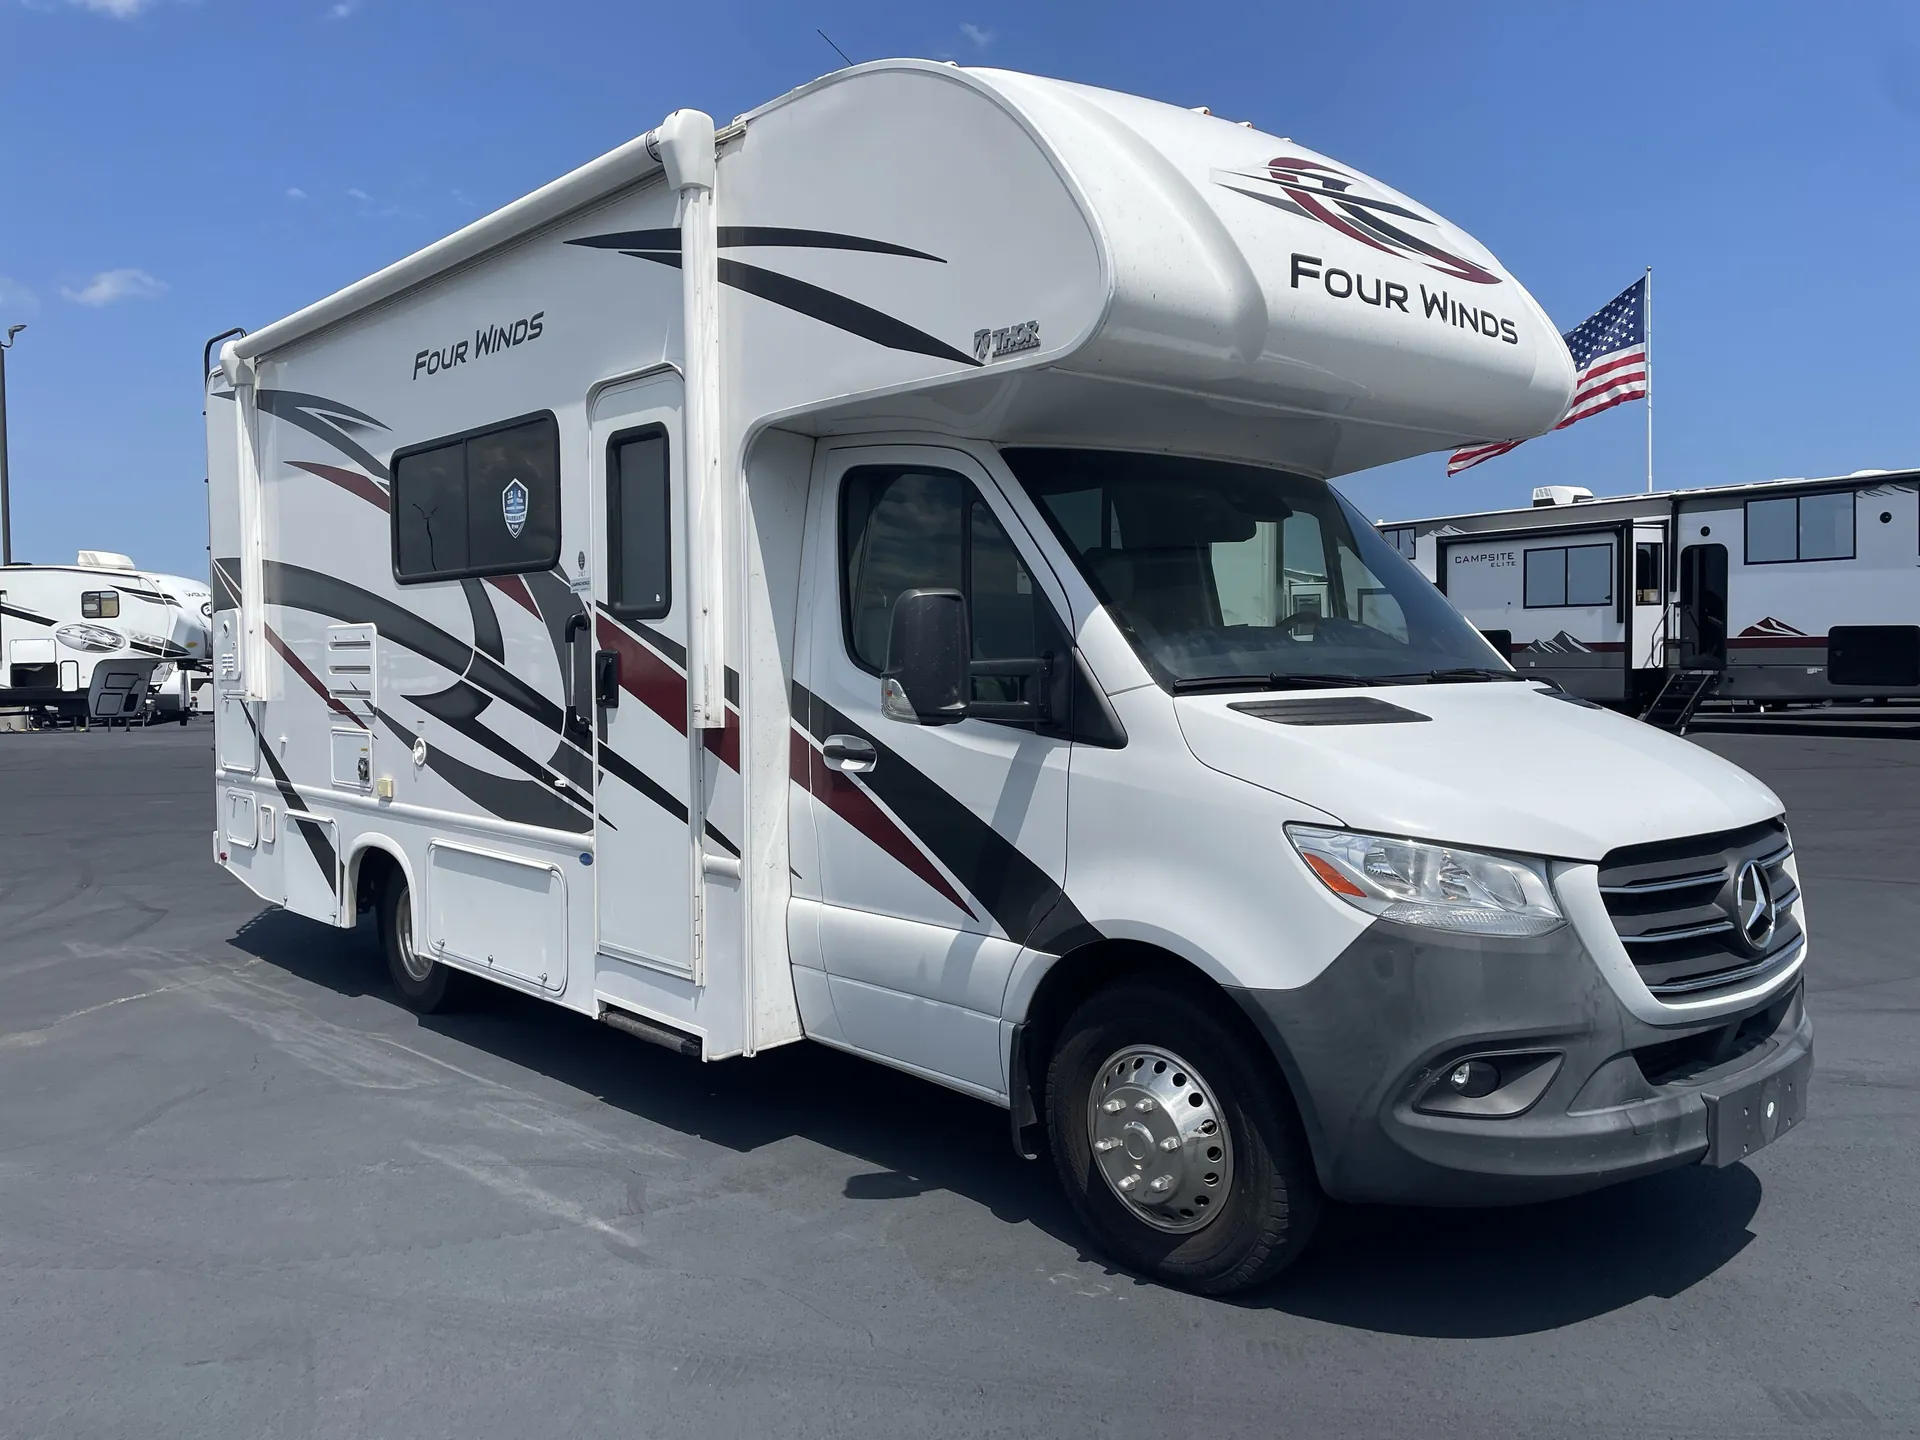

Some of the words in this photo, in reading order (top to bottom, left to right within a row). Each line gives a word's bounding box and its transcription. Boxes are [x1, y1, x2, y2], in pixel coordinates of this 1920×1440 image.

[1290, 252, 1410, 314] FOUR
[1419, 283, 1518, 345] WINDS
[413, 340, 469, 380] FOUR
[475, 311, 544, 359] WINDS
[992, 320, 1041, 351] THOR
[1455, 552, 1514, 564] CAMPSITE
